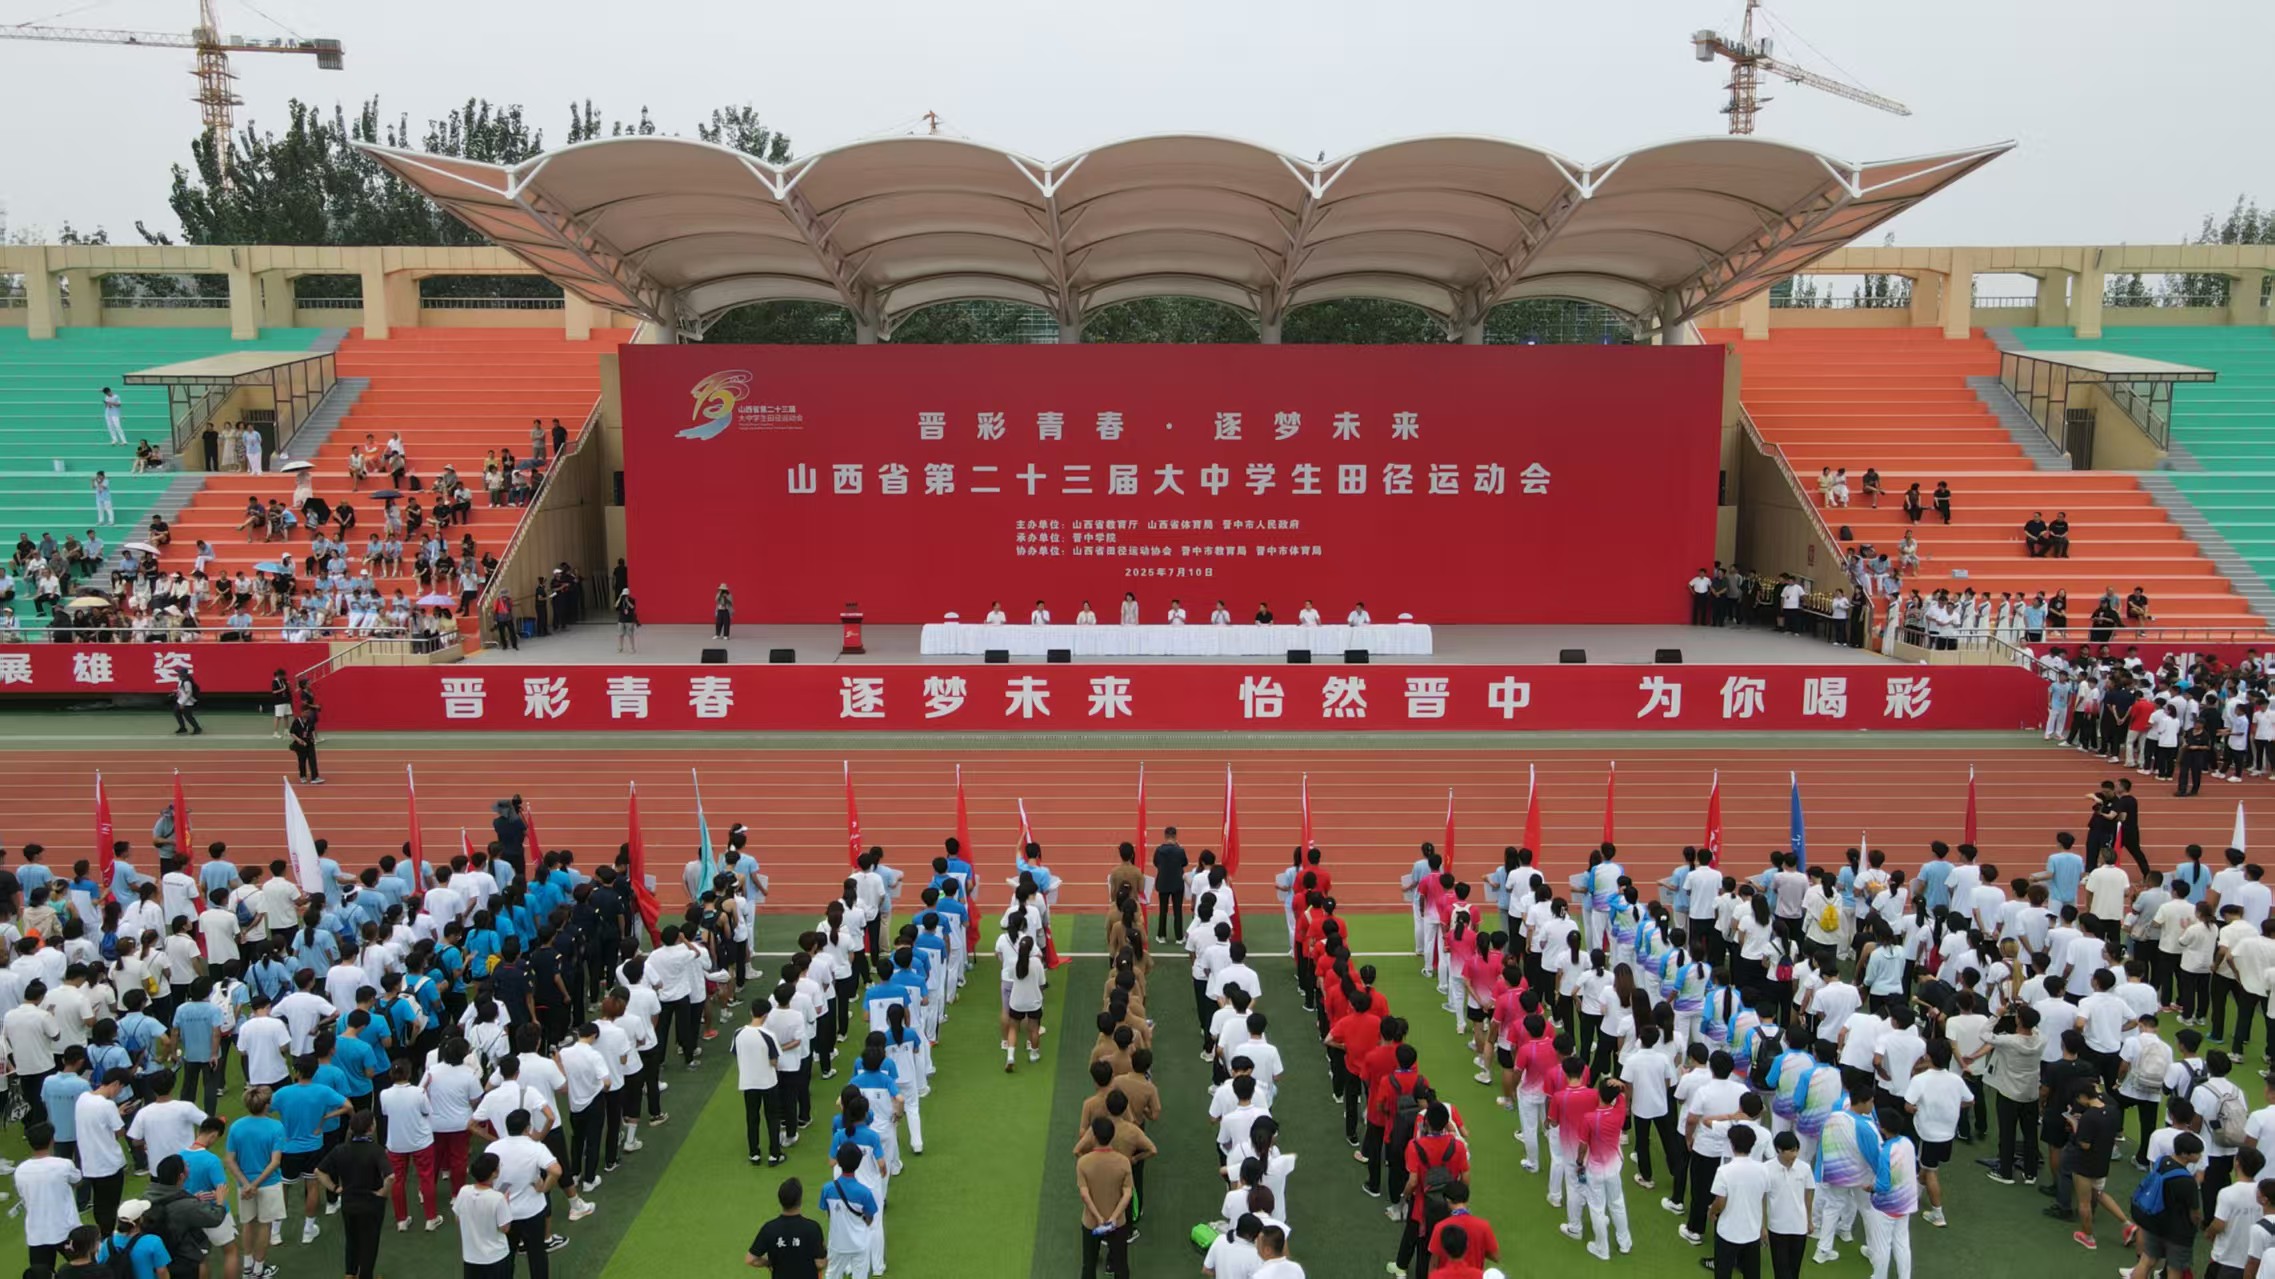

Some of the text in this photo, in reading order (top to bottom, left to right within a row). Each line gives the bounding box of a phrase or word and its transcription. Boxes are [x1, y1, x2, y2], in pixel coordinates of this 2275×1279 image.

[788, 462, 1551, 496] 山西省第二十三届大中学生田径运动会
[1148, 519, 1213, 530] 山西省体育局
[1223, 519, 1299, 530] 晋中市人民政府
[1182, 545, 1247, 556] 晋中市教育局
[1256, 545, 1322, 556] 晋中市体育局
[1125, 567, 1213, 577] 2025年7月10日
[440, 675, 1932, 719] 晋彩青春 逐梦未来 怡然晋中 为你喝彩
